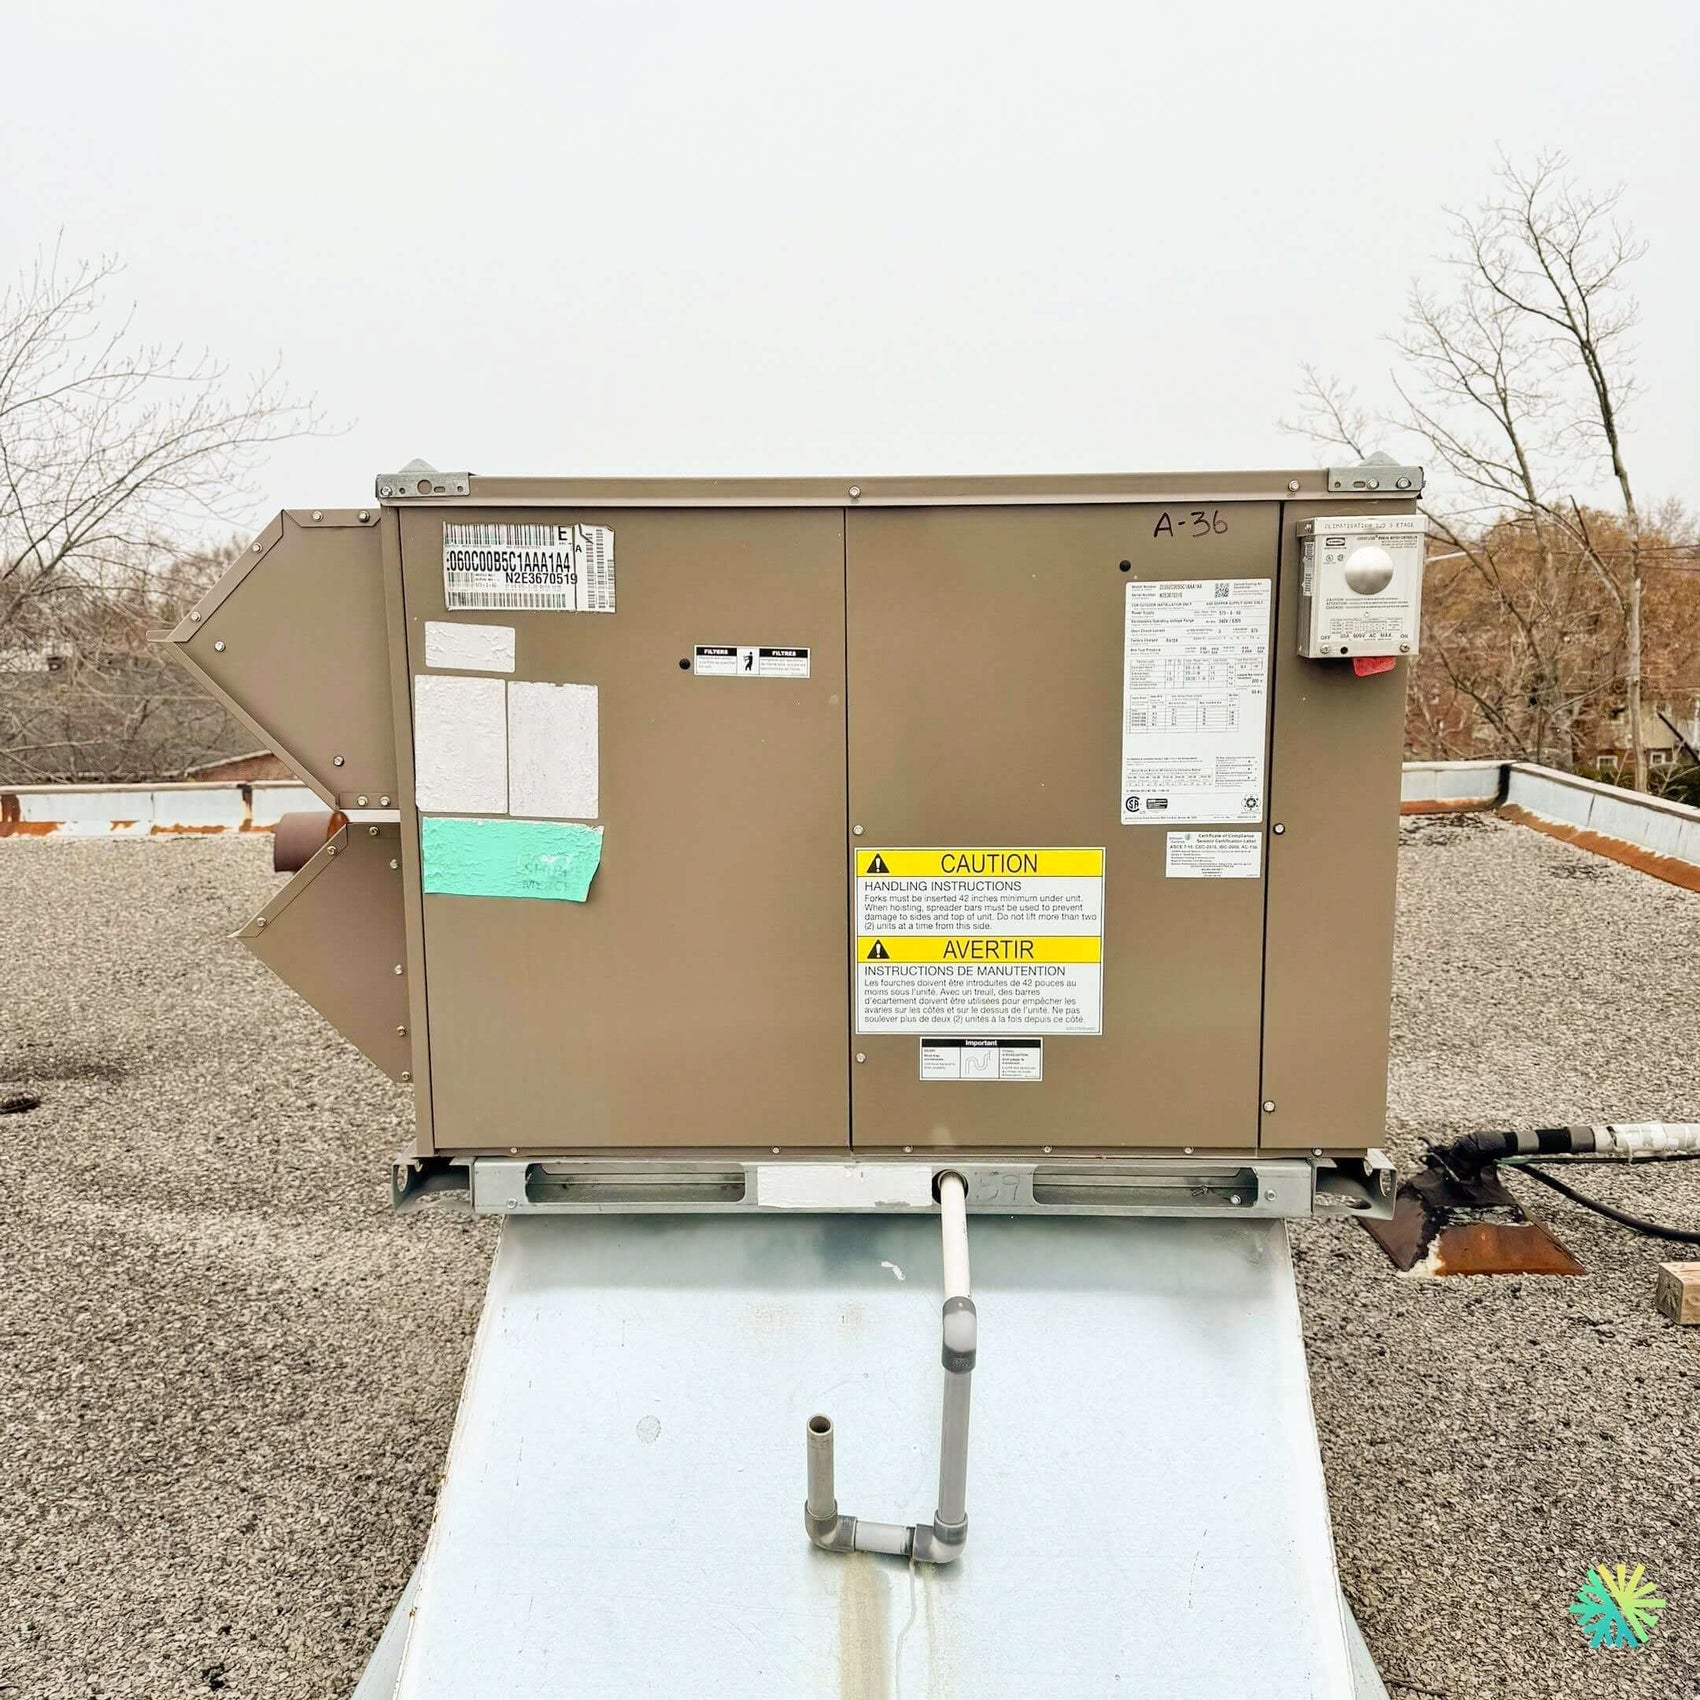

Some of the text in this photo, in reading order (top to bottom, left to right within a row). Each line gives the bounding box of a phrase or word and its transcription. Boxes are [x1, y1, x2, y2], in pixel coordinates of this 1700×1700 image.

[1154, 510, 1228, 537] A-36
[558, 525, 567, 541] E
[575, 544, 582, 552] A
[447, 550, 570, 573] 060C00B5C1AAA1A4
[505, 572, 578, 585] N2E3670519
[940, 853, 1038, 873] CAUTION
[865, 881, 1022, 891] HANDLING INSTRUCTIONS
[864, 894, 887, 902] Forks
[889, 894, 909, 902] must
[911, 894, 922, 902] be
[924, 894, 957, 902] inserted
[959, 894, 969, 902] 42
[971, 894, 998, 902] inches
[1000, 894, 1038, 902] minimum
[1039, 894, 1064, 902] under
[926, 904, 962, 913] spreader
[1052, 904, 1083, 913] prevent
[864, 913, 897, 922] damage
[951, 913, 964, 922] top
[864, 922, 875, 931] (2)
[876, 922, 897, 930] units
[898, 922, 906, 930] at
[915, 922, 934, 930] time
[935, 922, 954, 930] from
[956, 922, 971, 930] this
[943, 940, 1034, 959] AVERTIR
[865, 966, 1065, 976] INSTRUCTIONS DE MANUTENTION
[864, 988, 888, 996] moins
[940, 988, 960, 996] Avec
[998, 988, 1013, 996] des
[1015, 988, 1041, 996] barres
[864, 1006, 892, 1014] avaries
[909, 1006, 921, 1014] les
[947, 1006, 954, 1014] et
[971, 1006, 978, 1014] le
[980, 1006, 1009, 1014] dessus
[1011, 1006, 1021, 1014] de
[1052, 1006, 1063, 1014] Ne
[864, 1015, 898, 1023] soulever
[900, 1015, 917, 1025] plus
[918, 1015, 930, 1023] de
[931, 1015, 951, 1023] deux
[953, 1015, 963, 1025] (2)
[998, 1015, 1006, 1023] la
[1007, 1015, 1022, 1023] fois
[1024, 1015, 1052, 1025] depuis
